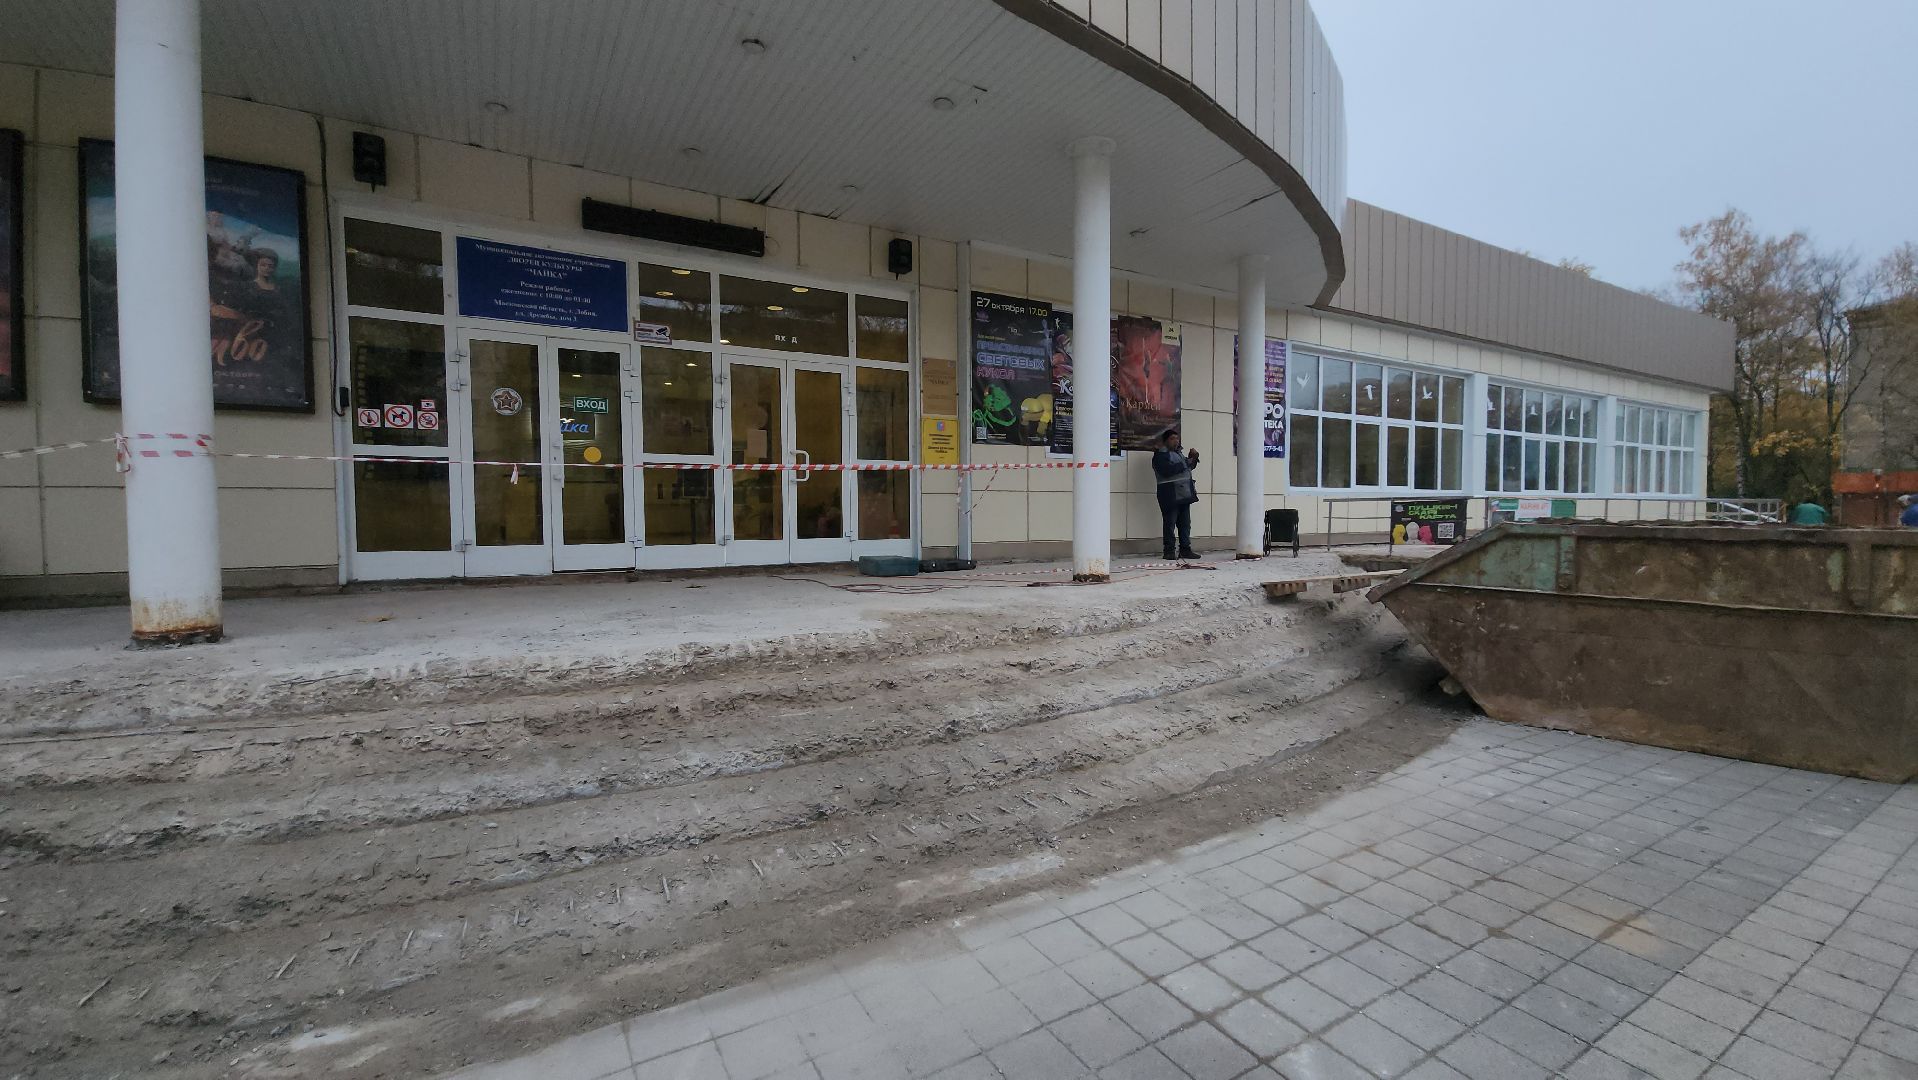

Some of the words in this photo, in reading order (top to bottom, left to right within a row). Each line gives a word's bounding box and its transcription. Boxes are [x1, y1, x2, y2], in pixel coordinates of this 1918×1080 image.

[520, 281, 544, 291] Режим
[976, 296, 991, 308] 27
[991, 302, 1025, 315] октября
[1028, 306, 1048, 317] 17.00
[976, 352, 1046, 371] СВЕТОВЫХ
[976, 365, 1016, 380] КУКОЛ
[576, 399, 606, 411] ВХОД
[1264, 420, 1284, 429] ТЕКА
